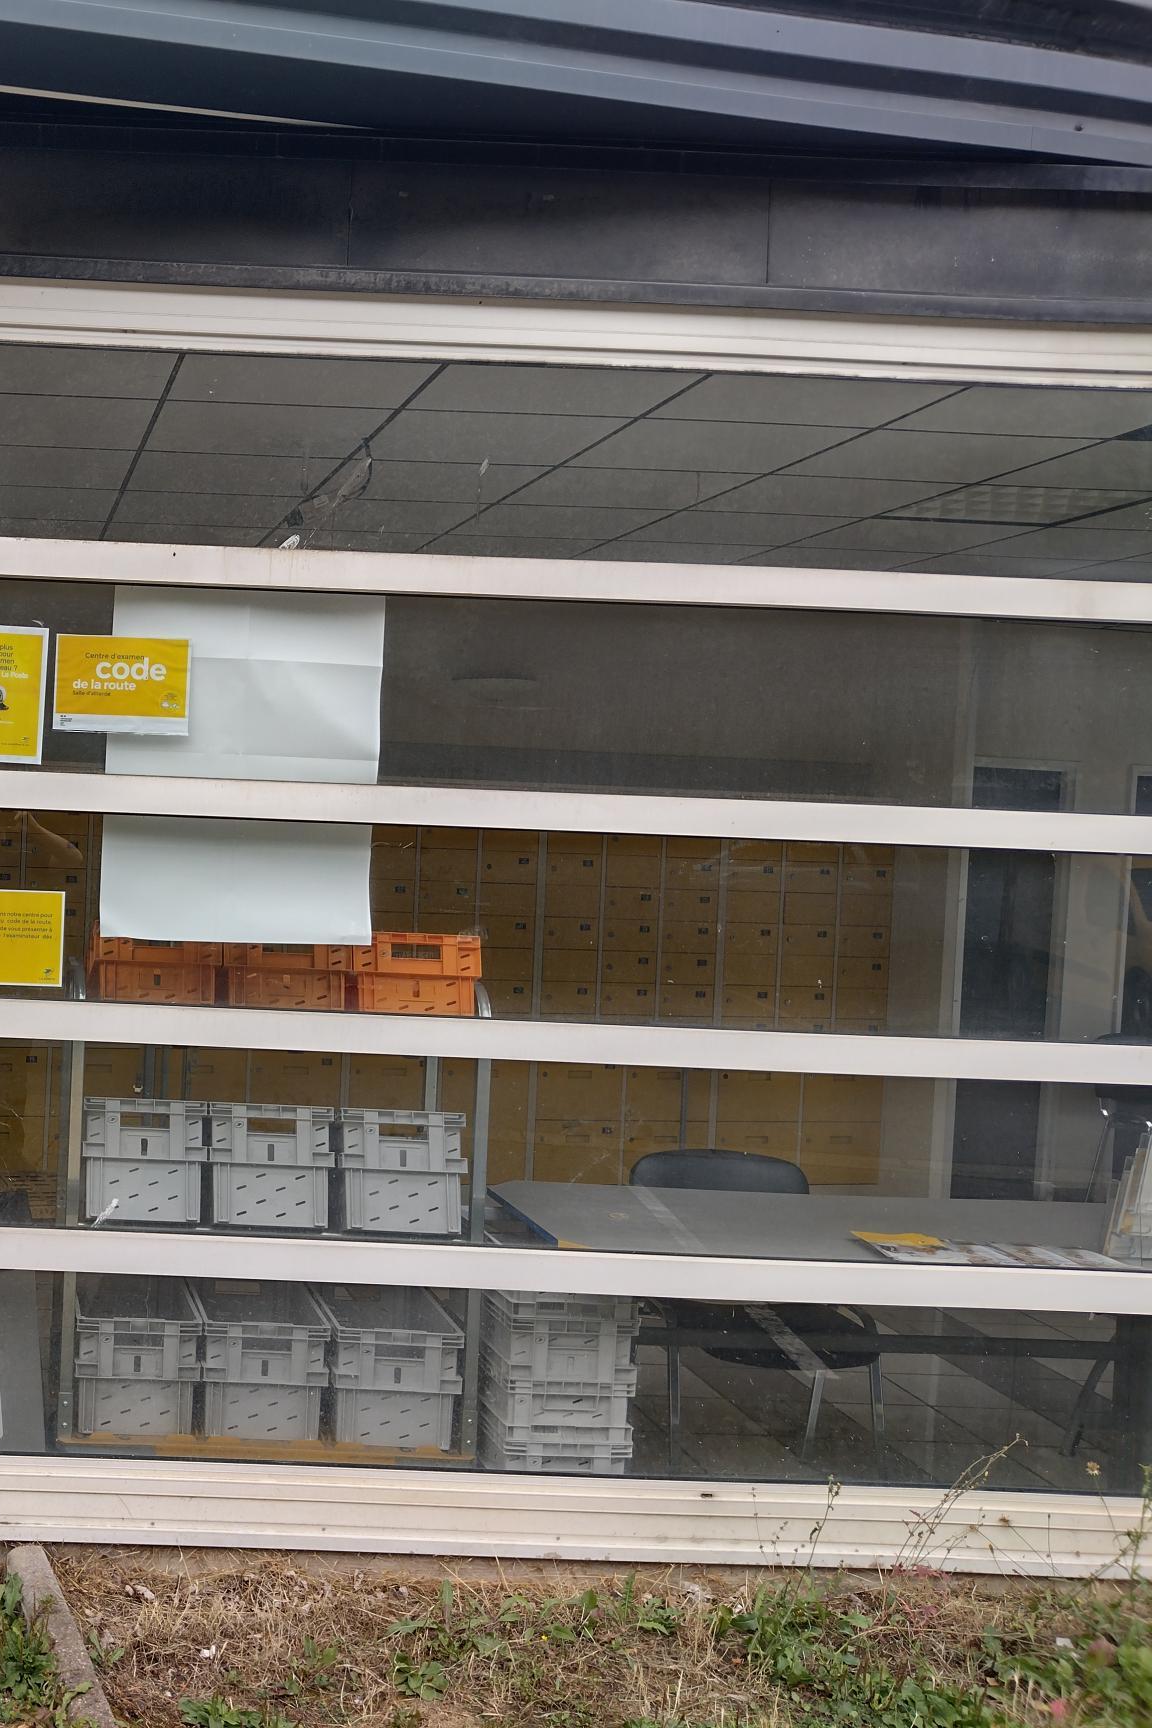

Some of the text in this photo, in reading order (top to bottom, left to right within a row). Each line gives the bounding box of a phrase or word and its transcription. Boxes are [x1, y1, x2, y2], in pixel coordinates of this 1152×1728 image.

[96, 657, 166, 680] code
[73, 679, 136, 691] de la route
